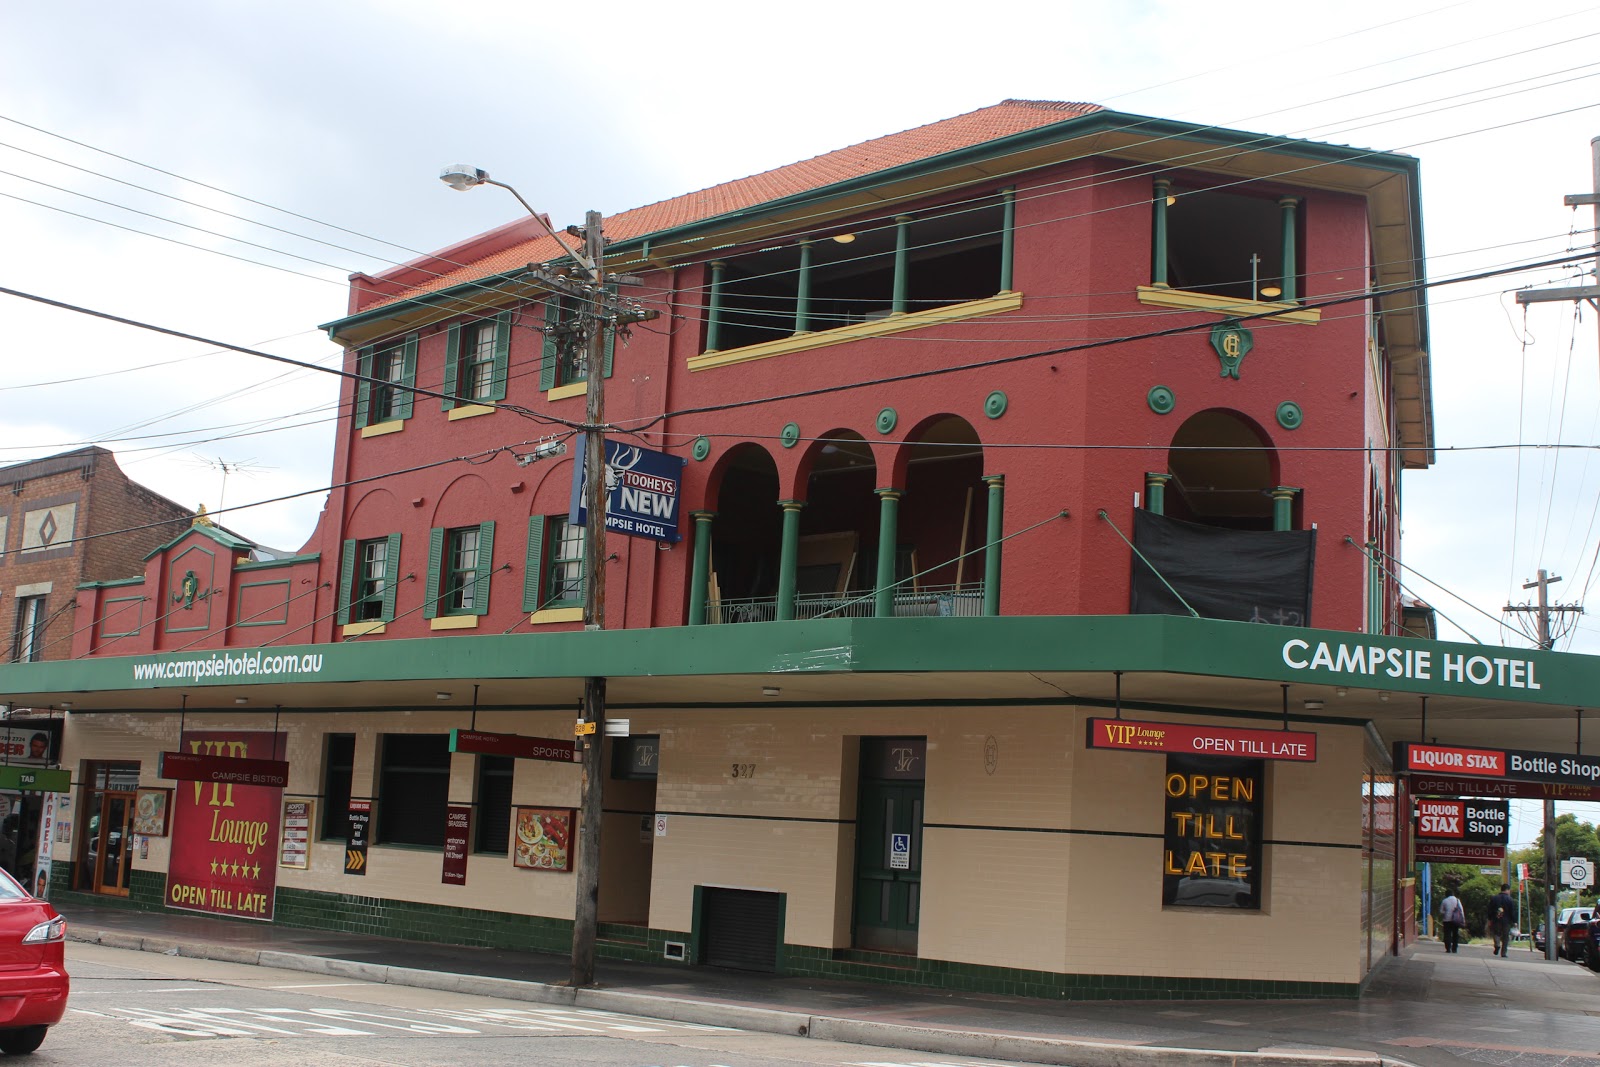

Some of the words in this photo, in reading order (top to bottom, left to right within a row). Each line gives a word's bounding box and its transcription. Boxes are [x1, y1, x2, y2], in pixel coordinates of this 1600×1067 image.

[626, 472, 674, 493] TOOHEYS
[620, 486, 676, 519] NEW
[635, 522, 666, 537] HOTEL
[133, 651, 323, 682] www.campsiehotel.com.au
[1282, 638, 1431, 680] CAMPSIE
[1443, 652, 1541, 690] HOTEL
[1105, 724, 1136, 745] VIP
[1137, 727, 1165, 740] Lounge
[533, 746, 571, 759] SPORTS
[1192, 737, 1235, 752] OPEN
[1238, 740, 1268, 754] TILL
[1272, 742, 1307, 757] LATE
[732, 763, 757, 779] 327
[1413, 750, 1463, 767] LIQUOR
[1466, 754, 1498, 770] STAX
[1511, 755, 1557, 774] Bottle
[1560, 759, 1600, 780] Shop
[21, 775, 35, 783] TAB
[212, 771, 250, 782] CAMPSIE
[252, 774, 284, 784] BISTRO
[1165, 772, 1254, 802] OPEN
[1418, 781, 1454, 792] OPEN
[1457, 782, 1483, 793] TILL
[1486, 784, 1517, 794] LATE
[1422, 804, 1459, 816] LIQUOR
[1466, 807, 1506, 820] Bottle
[209, 809, 269, 855] Lounge
[1171, 811, 1243, 840] TILL
[1421, 815, 1460, 834] STAX
[1468, 821, 1504, 836] Shop
[1422, 845, 1464, 855] CAMPSIE
[1467, 847, 1498, 857] HOTEL
[1164, 850, 1248, 878] LATE
[1573, 869, 1584, 877] 40
[171, 883, 206, 906] OPEN
[210, 889, 233, 909] TILL
[237, 892, 267, 913] LATE
